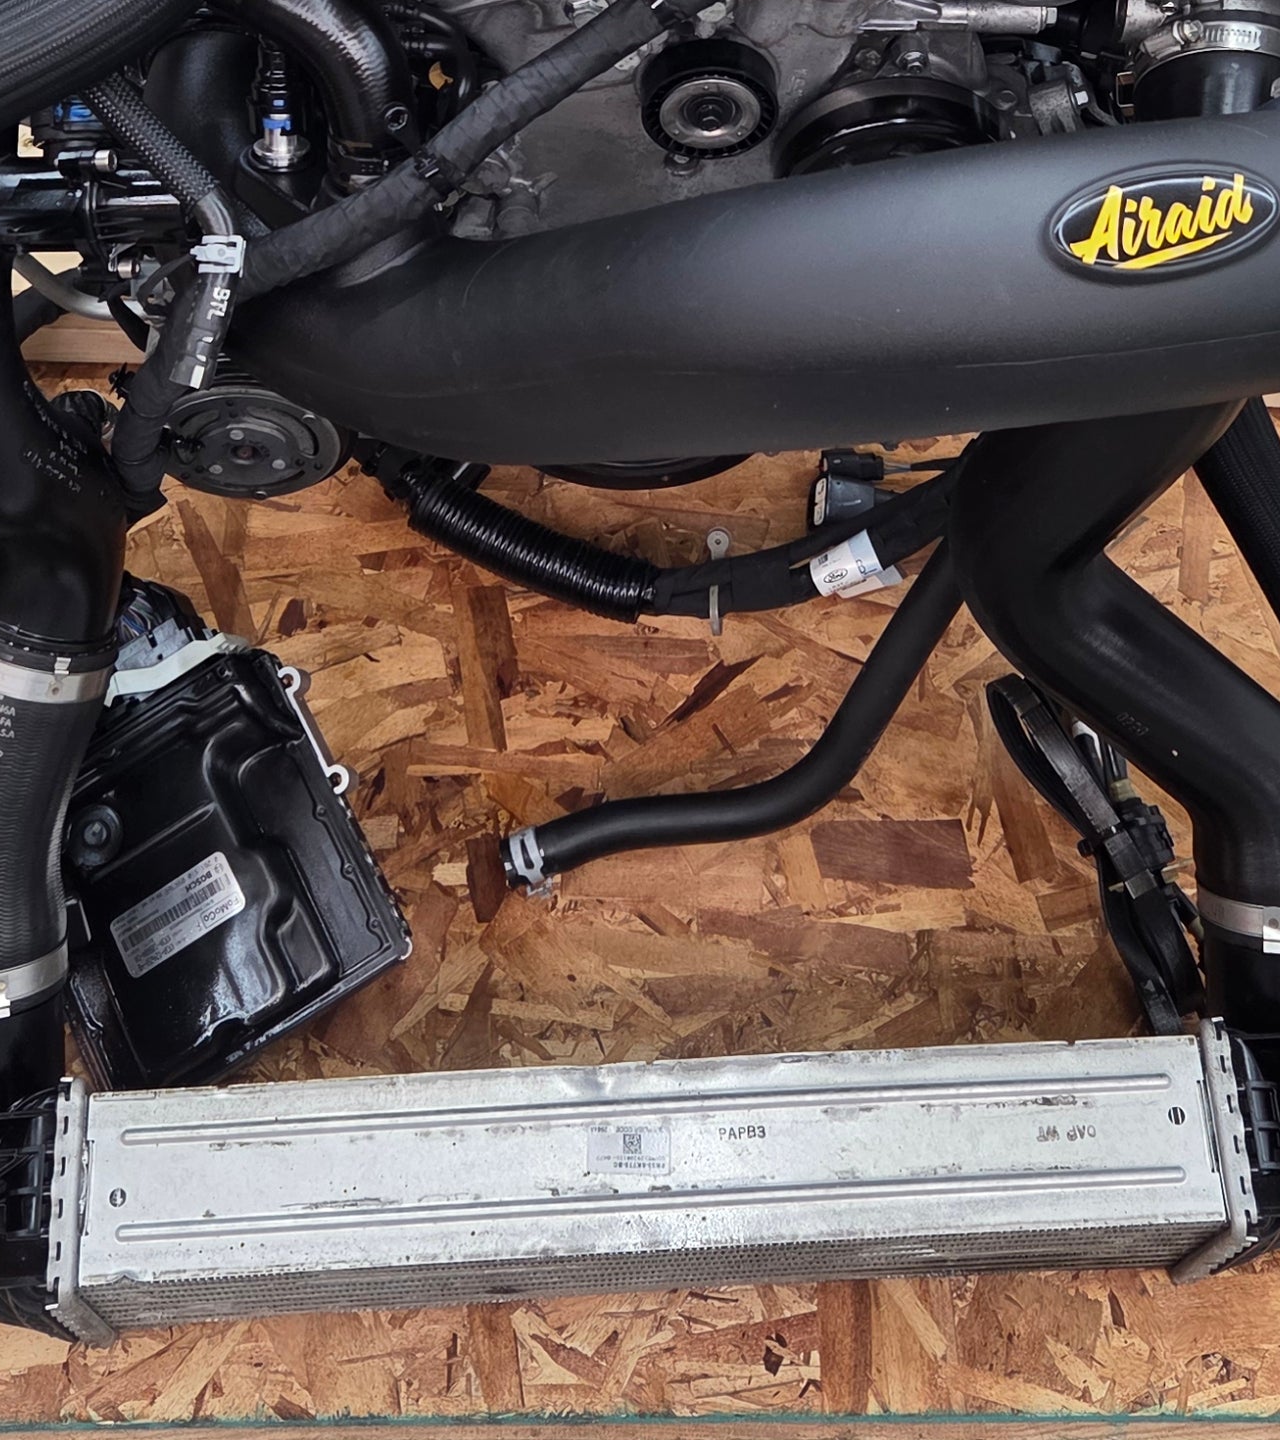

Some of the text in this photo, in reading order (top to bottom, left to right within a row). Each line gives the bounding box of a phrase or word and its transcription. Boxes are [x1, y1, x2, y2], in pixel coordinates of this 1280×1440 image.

[1069, 173, 1253, 270] Airaid
[184, 870, 213, 893] BOSCH
[203, 897, 240, 922] FoMoCo
[718, 1125, 767, 1142] PAPB3
